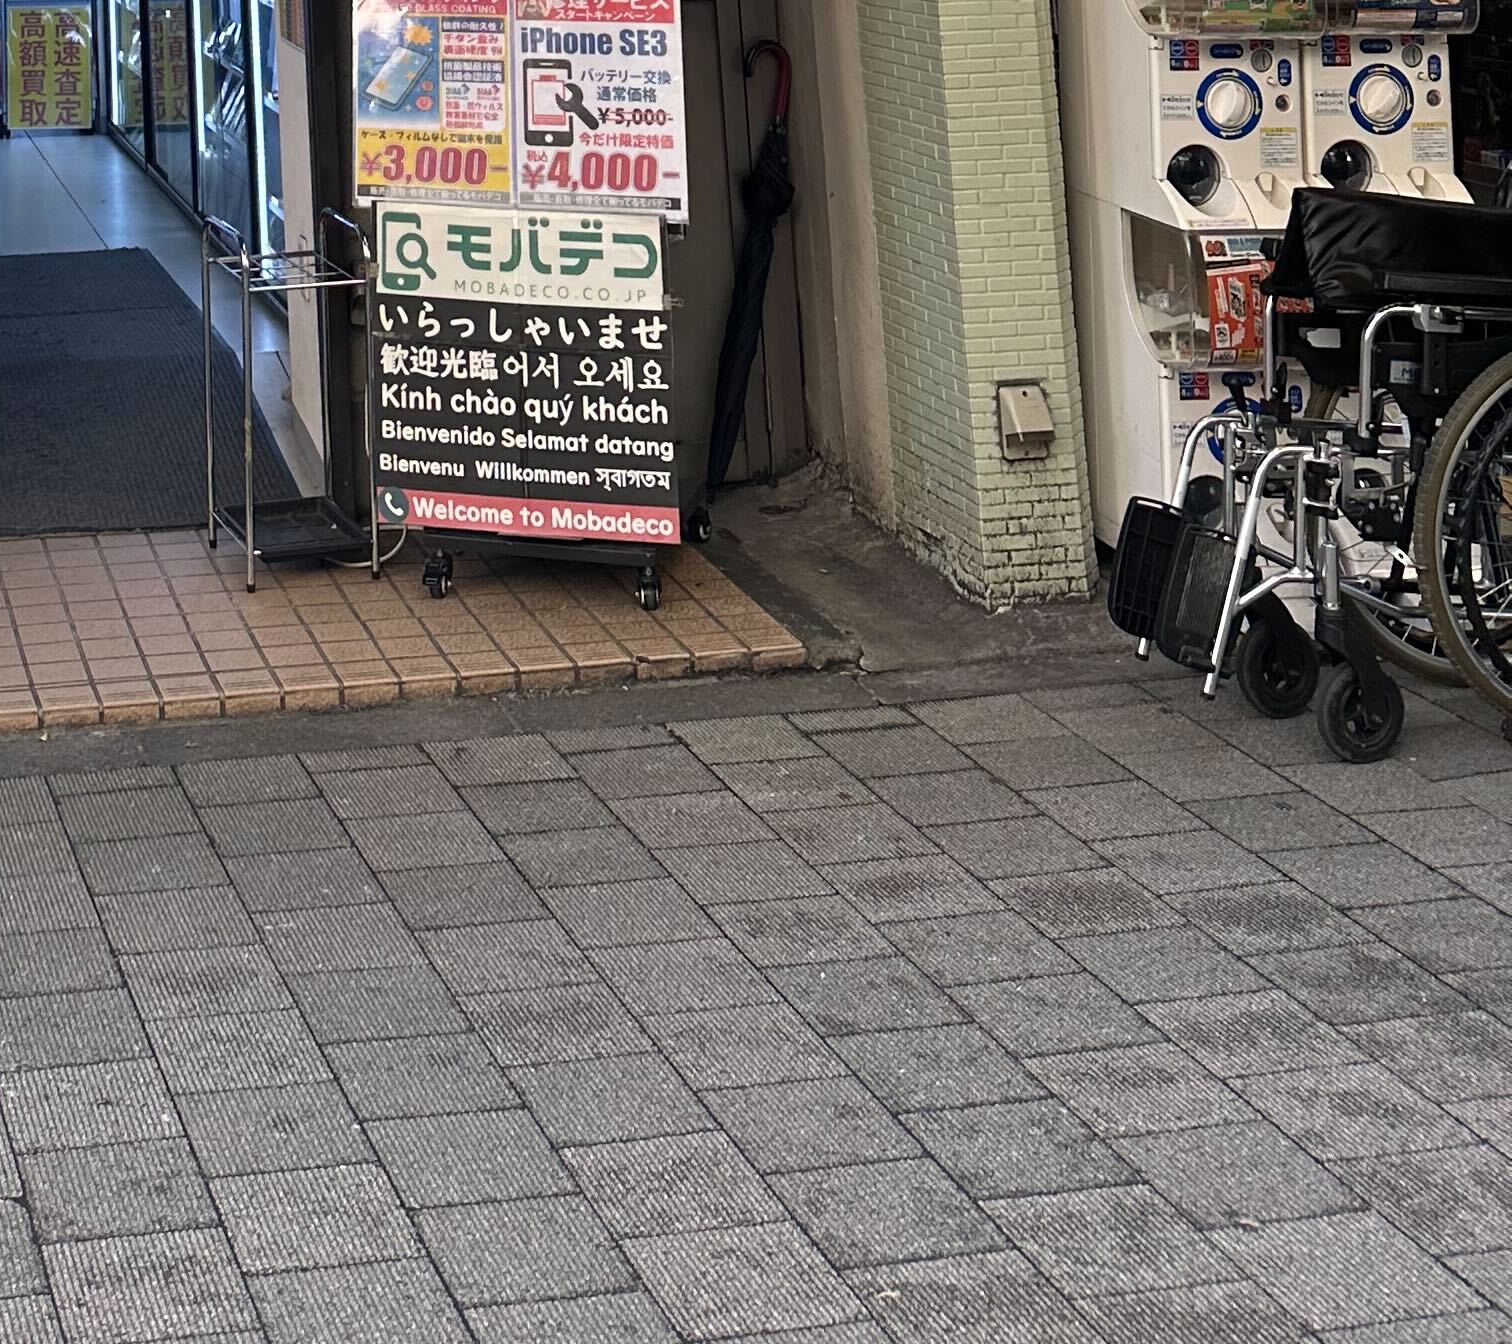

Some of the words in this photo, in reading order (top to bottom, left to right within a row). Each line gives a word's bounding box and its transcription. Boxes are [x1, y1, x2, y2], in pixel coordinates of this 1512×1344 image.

[520, 26, 614, 57] iPhone
[618, 28, 668, 58] SE3
[19, 10, 48, 126] 高額買取
[53, 10, 83, 126] 高速査定
[580, 68, 673, 86] バッテリー交換
[596, 85, 658, 104] 通常価格
[578, 132, 675, 151] 今だけ限定特価
[446, 215, 660, 281] モバデコ
[453, 278, 649, 304] MOBADECO.CO.JP
[377, 300, 669, 351] いらっしゃいませ
[502, 350, 561, 390] 어서
[572, 355, 671, 394] 오세요
[380, 382, 443, 412] Kính
[449, 386, 518, 417] chào
[523, 393, 574, 427] quý
[582, 394, 669, 426] khách
[380, 419, 497, 448] Bienvenido
[500, 428, 590, 455] Selamat
[594, 433, 675, 464] datang
[378, 452, 466, 479] Bienvenu
[474, 459, 591, 487] Willkommen
[410, 496, 515, 526] Welcome
[518, 504, 546, 529] to
[550, 505, 676, 538] Mobadeco
